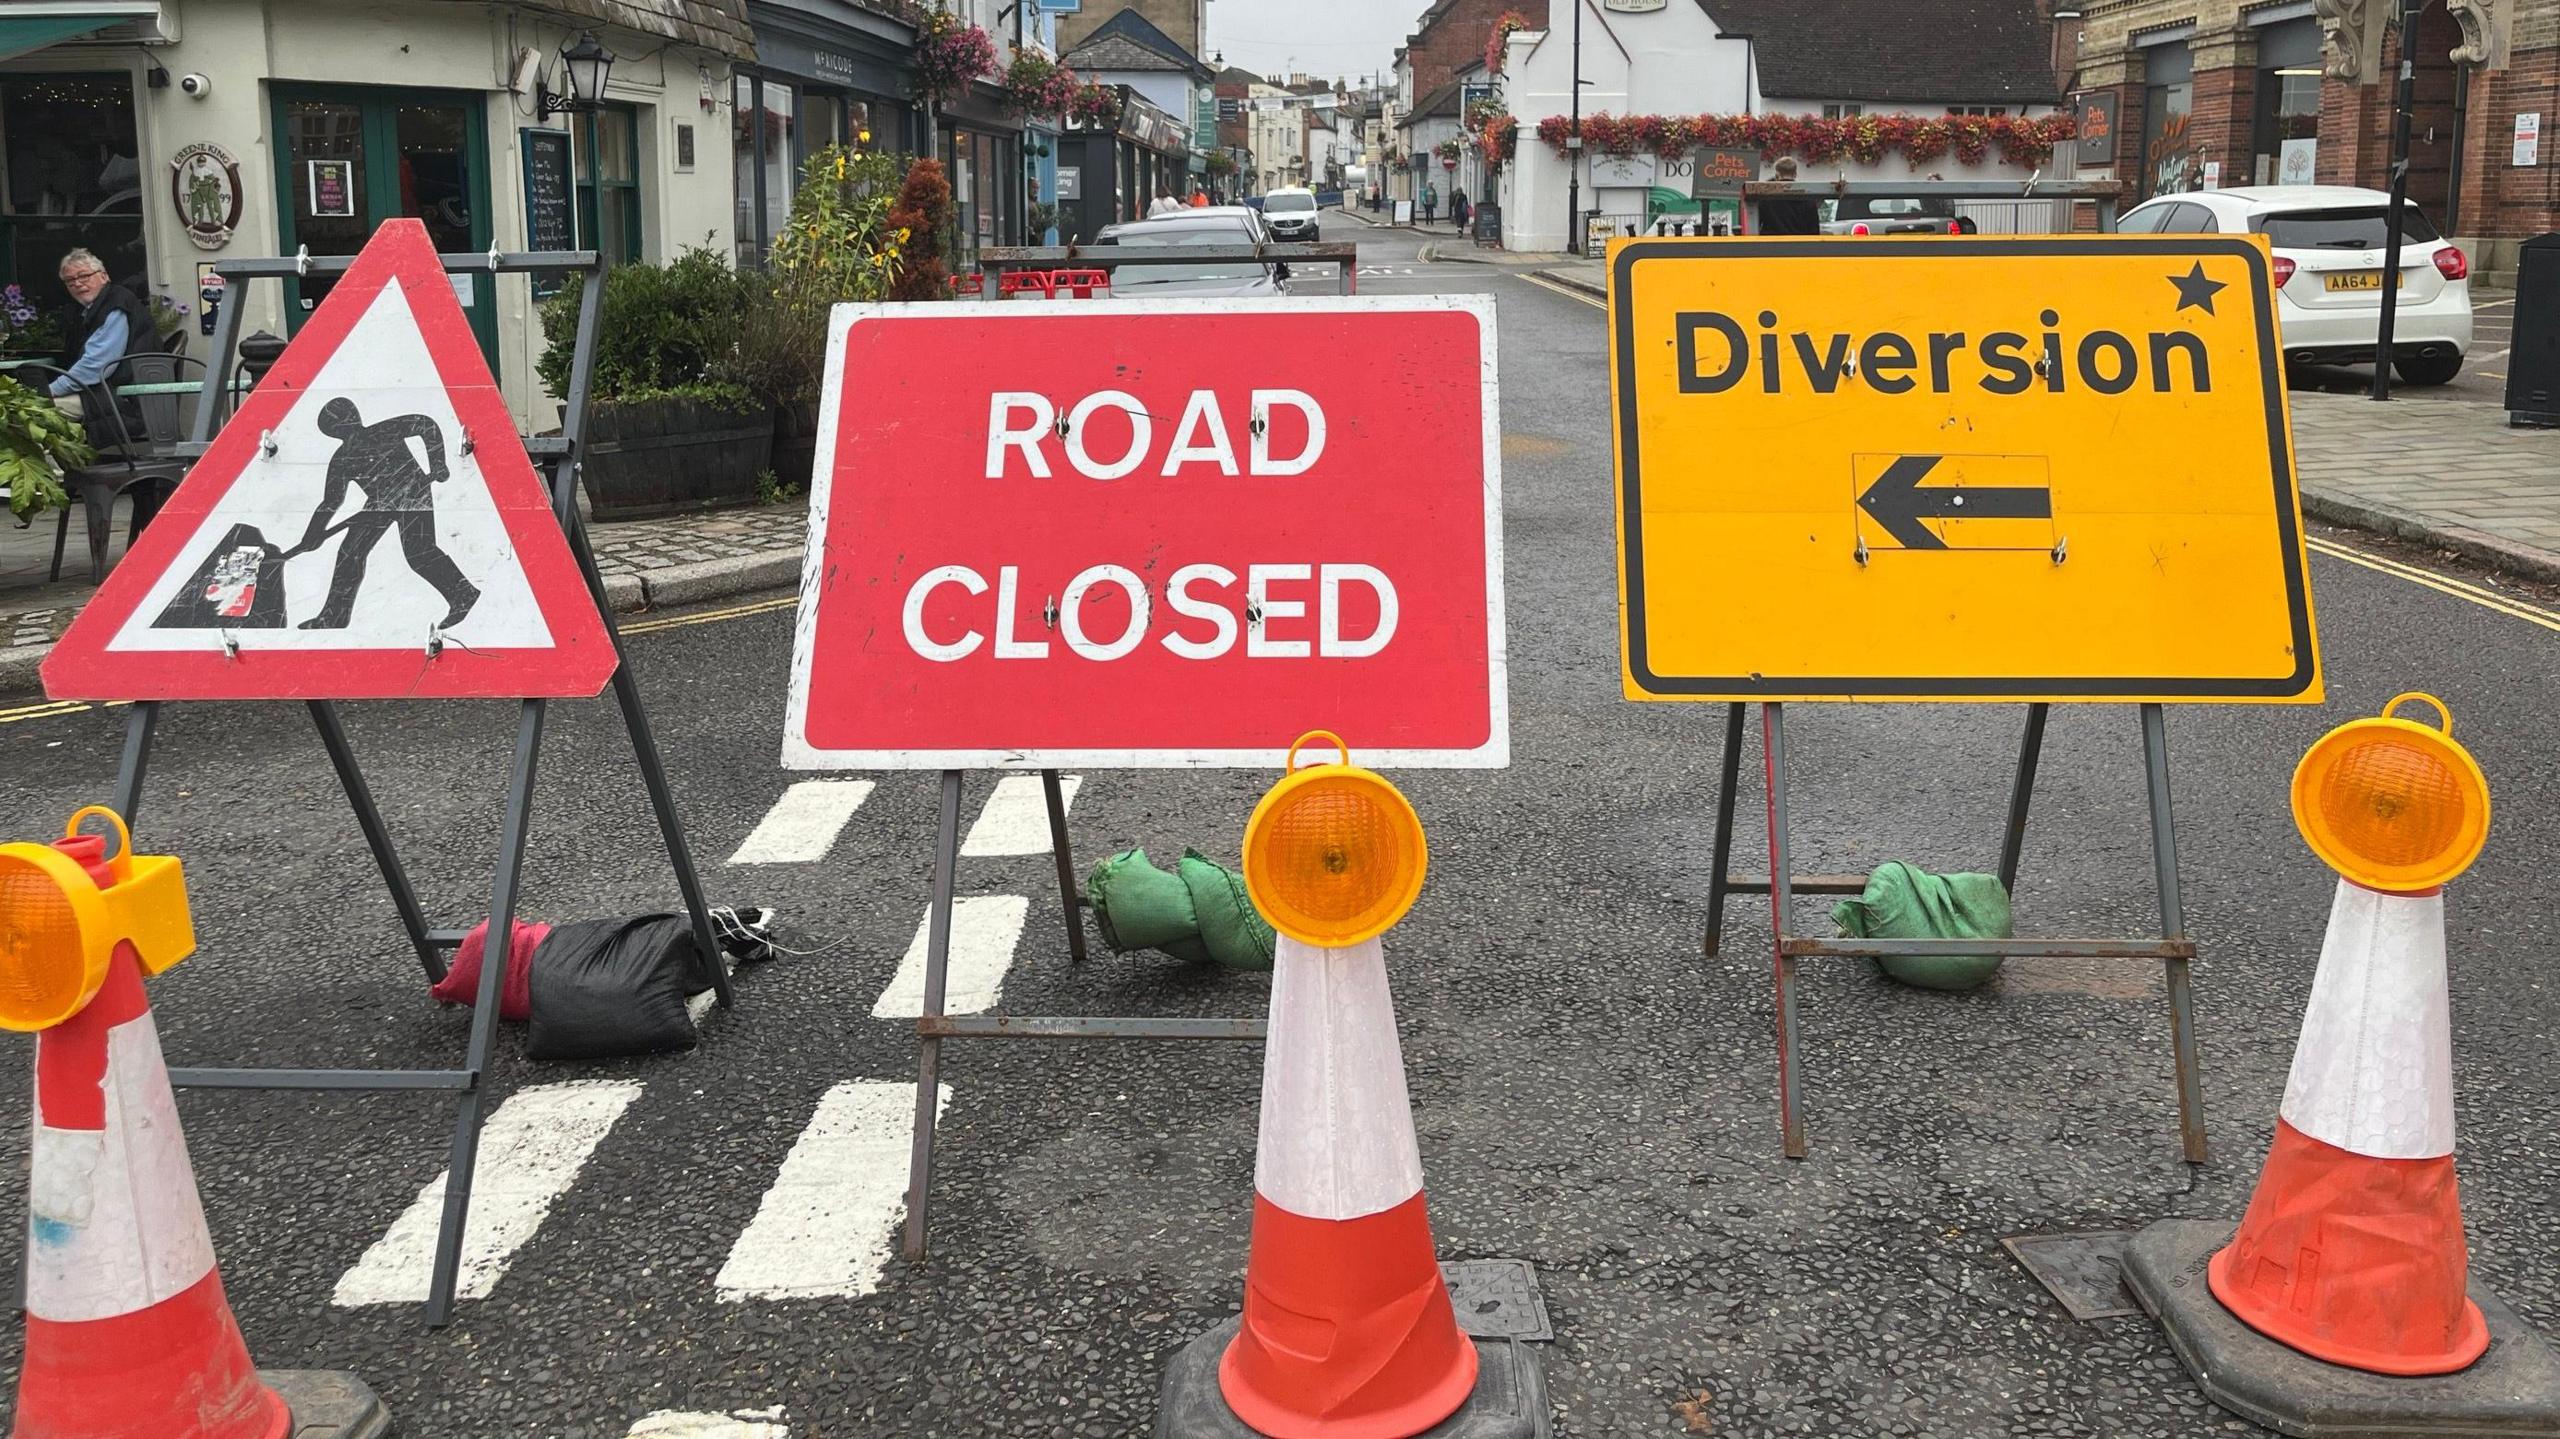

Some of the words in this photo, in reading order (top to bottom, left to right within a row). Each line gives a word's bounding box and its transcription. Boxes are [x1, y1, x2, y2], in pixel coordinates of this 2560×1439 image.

[2088, 105, 2105, 122] Pets
[2081, 121, 2110, 140] Corner
[174, 143, 206, 164] GREENE
[207, 144, 230, 164] KING
[1715, 151, 1745, 168] Pets
[1703, 163, 1751, 178] Corner
[219, 193, 231, 203] 99
[2331, 275, 2368, 289] AA64
[1675, 309, 2213, 396] Diversion
[985, 388, 1327, 480] ROAD
[902, 563, 1399, 662] CLOSED
